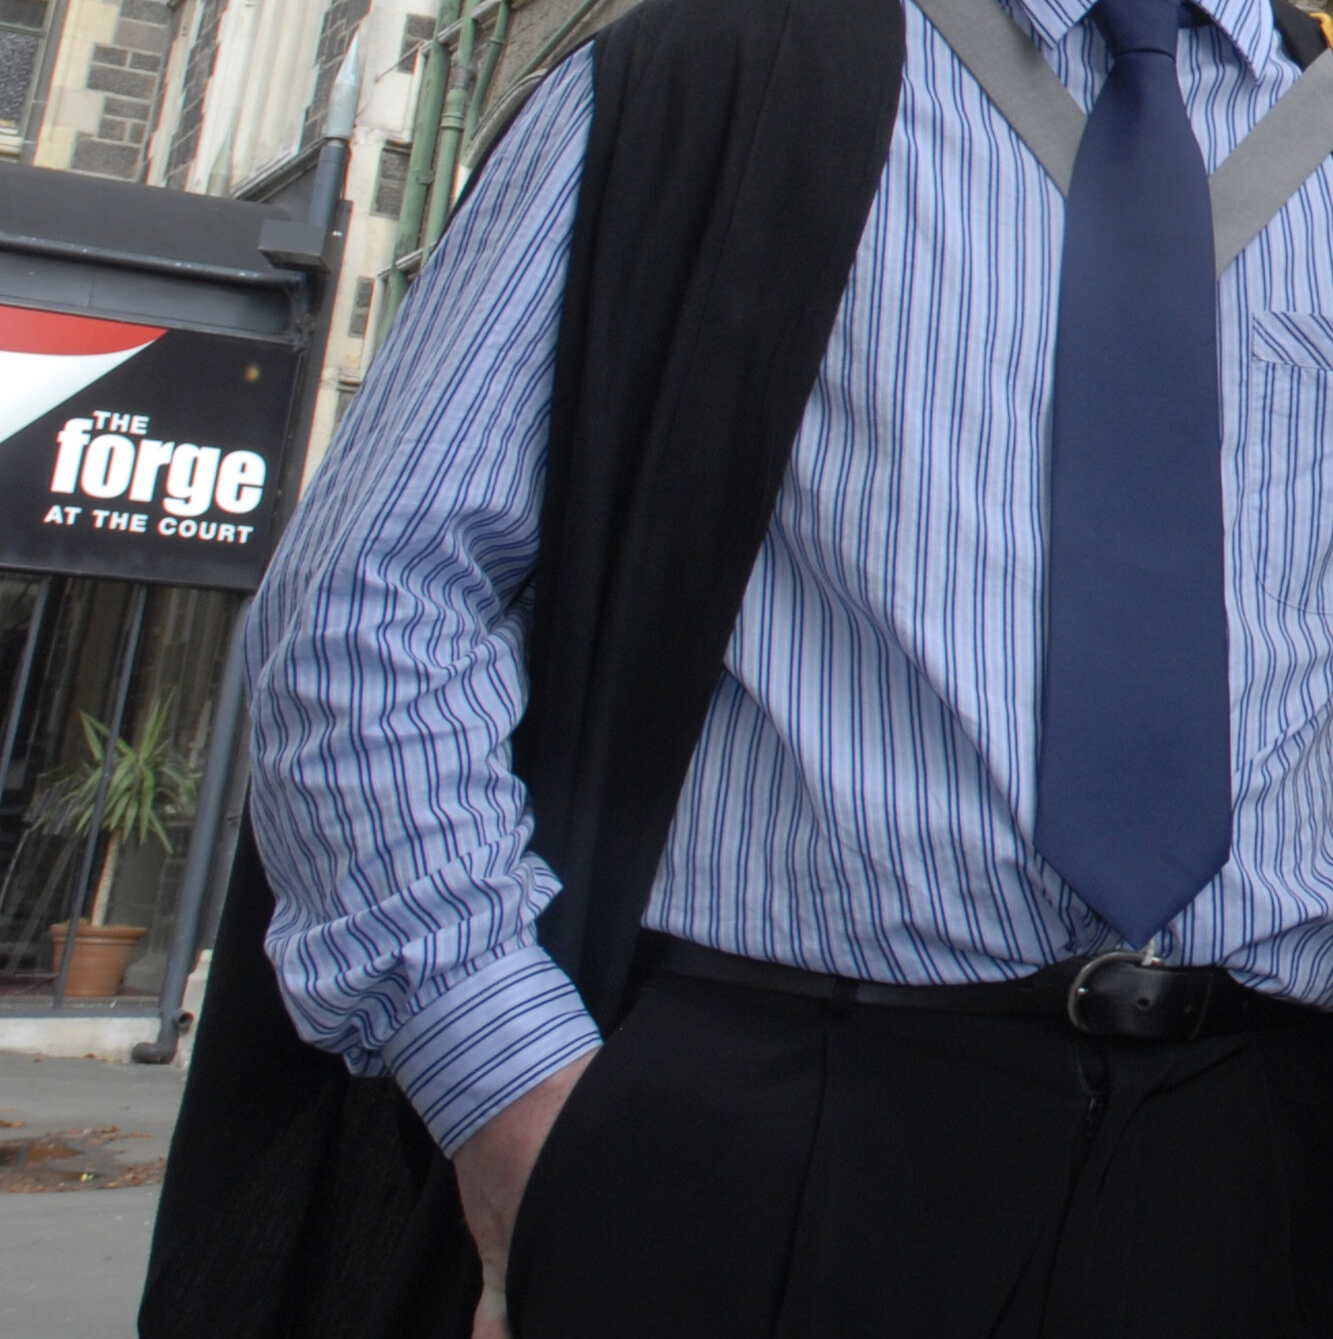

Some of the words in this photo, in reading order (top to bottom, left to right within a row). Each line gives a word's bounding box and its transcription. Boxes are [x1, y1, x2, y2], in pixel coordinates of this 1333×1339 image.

[93, 410, 150, 435] THE
[50, 418, 267, 517] forge
[43, 505, 82, 526] AT
[93, 510, 149, 533] THE
[157, 517, 254, 544] COURT
